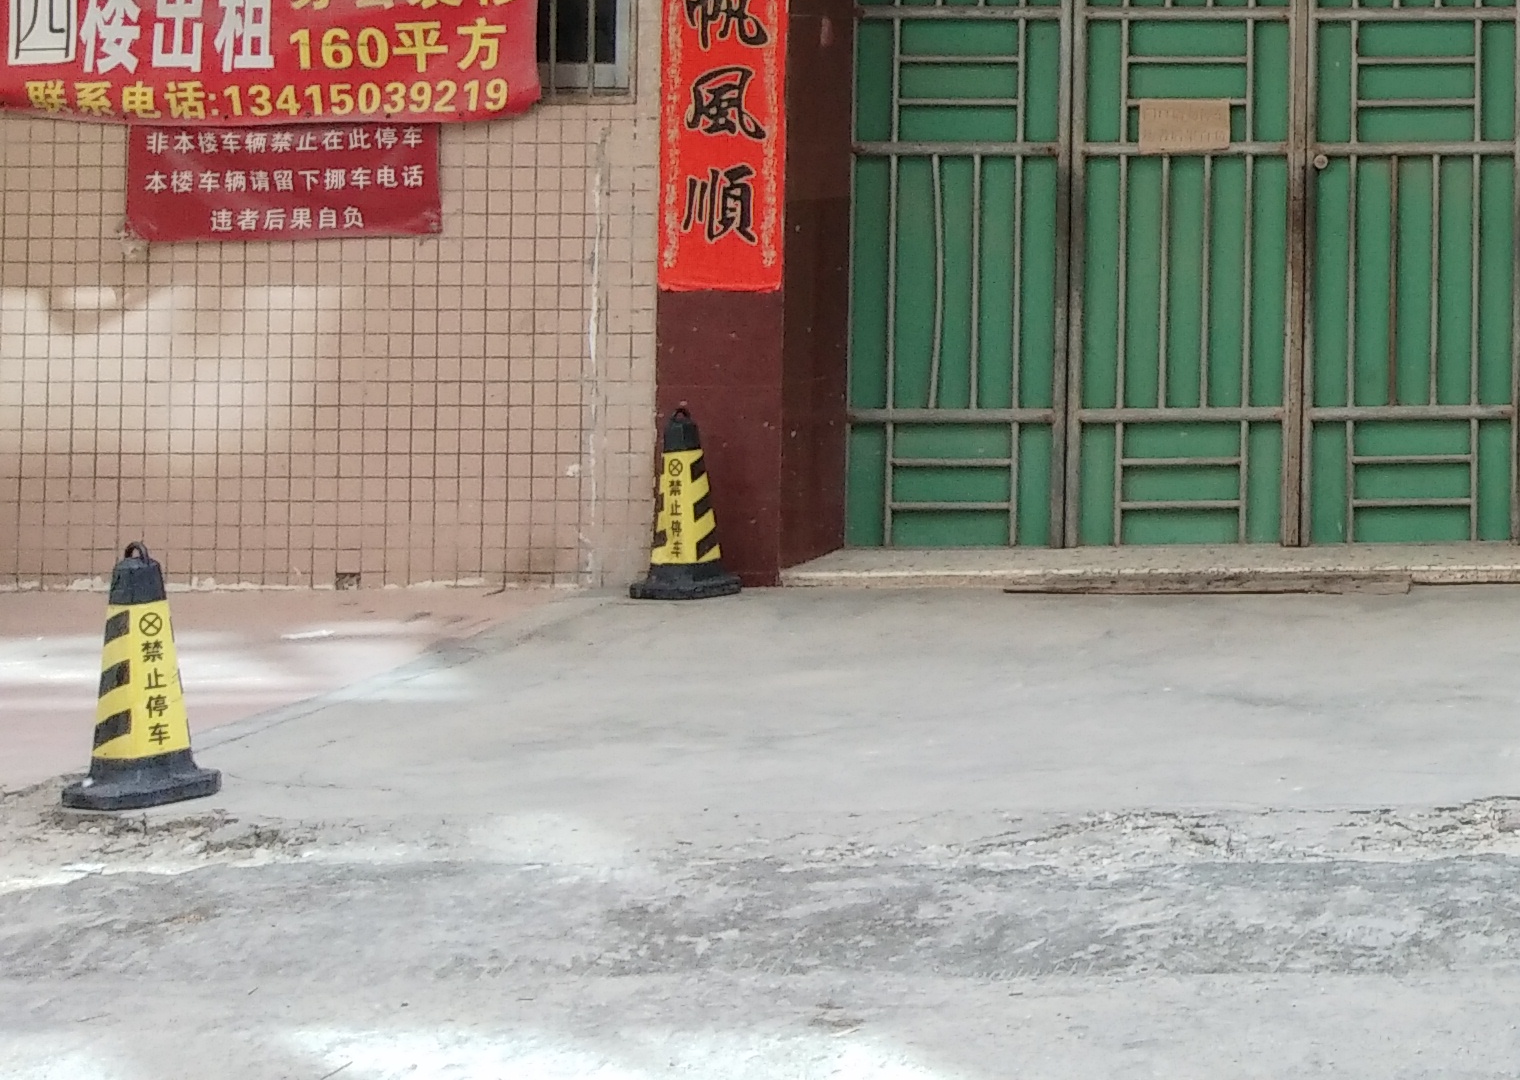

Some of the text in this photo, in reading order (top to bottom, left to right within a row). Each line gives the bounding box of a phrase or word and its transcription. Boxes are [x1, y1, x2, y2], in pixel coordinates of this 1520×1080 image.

[288, 16, 508, 74] 160平方
[146, 126, 424, 155] 非本楼车辆禁止在此停车
[144, 164, 425, 194] 本楼车辆请留下挪车电话
[210, 206, 365, 232] 违者后果自负
[668, 479, 683, 559] 禁止停车
[140, 639, 171, 746] 禁止停车
